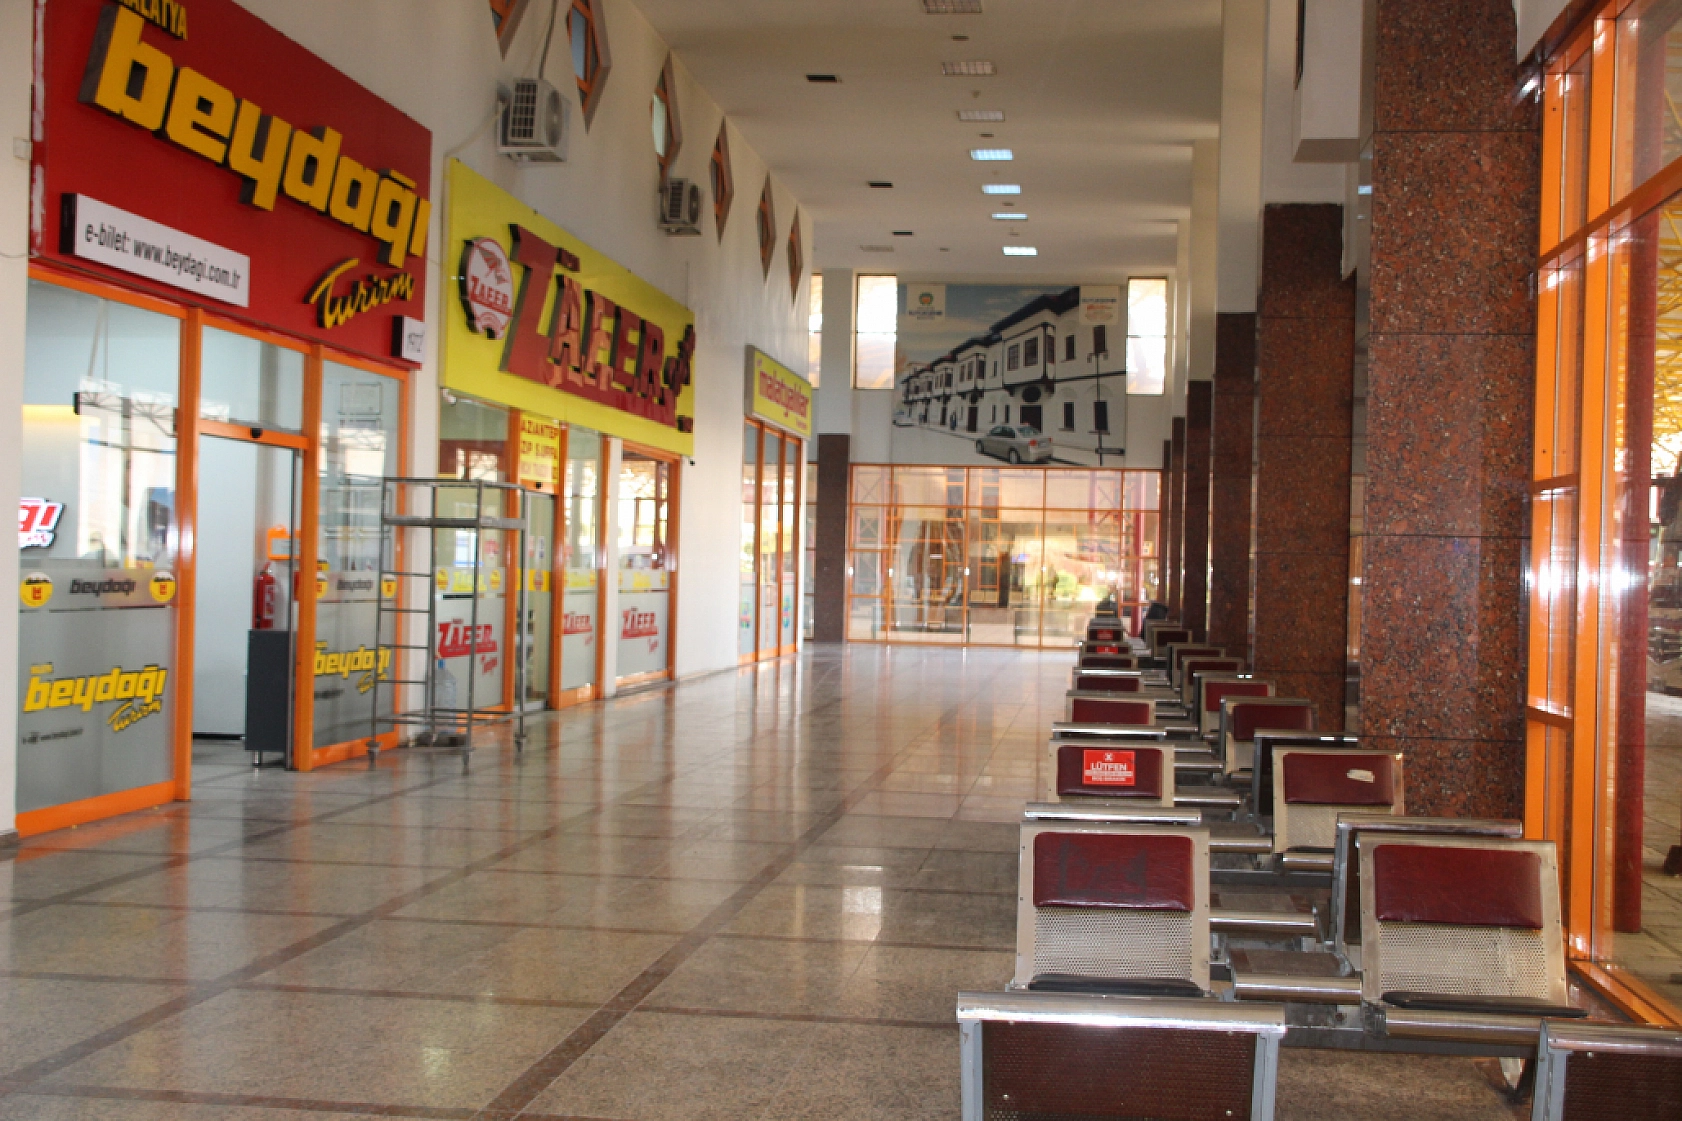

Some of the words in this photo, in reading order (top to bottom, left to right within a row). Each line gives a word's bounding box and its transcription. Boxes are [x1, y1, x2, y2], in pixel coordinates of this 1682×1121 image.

[85, 223, 130, 253] e-bilet:
[133, 239, 241, 290] www.beydagi.com.tr
[470, 275, 509, 308] ZAFER
[500, 223, 675, 416] ZAFER
[1091, 760, 1127, 771] LÜTFEN
